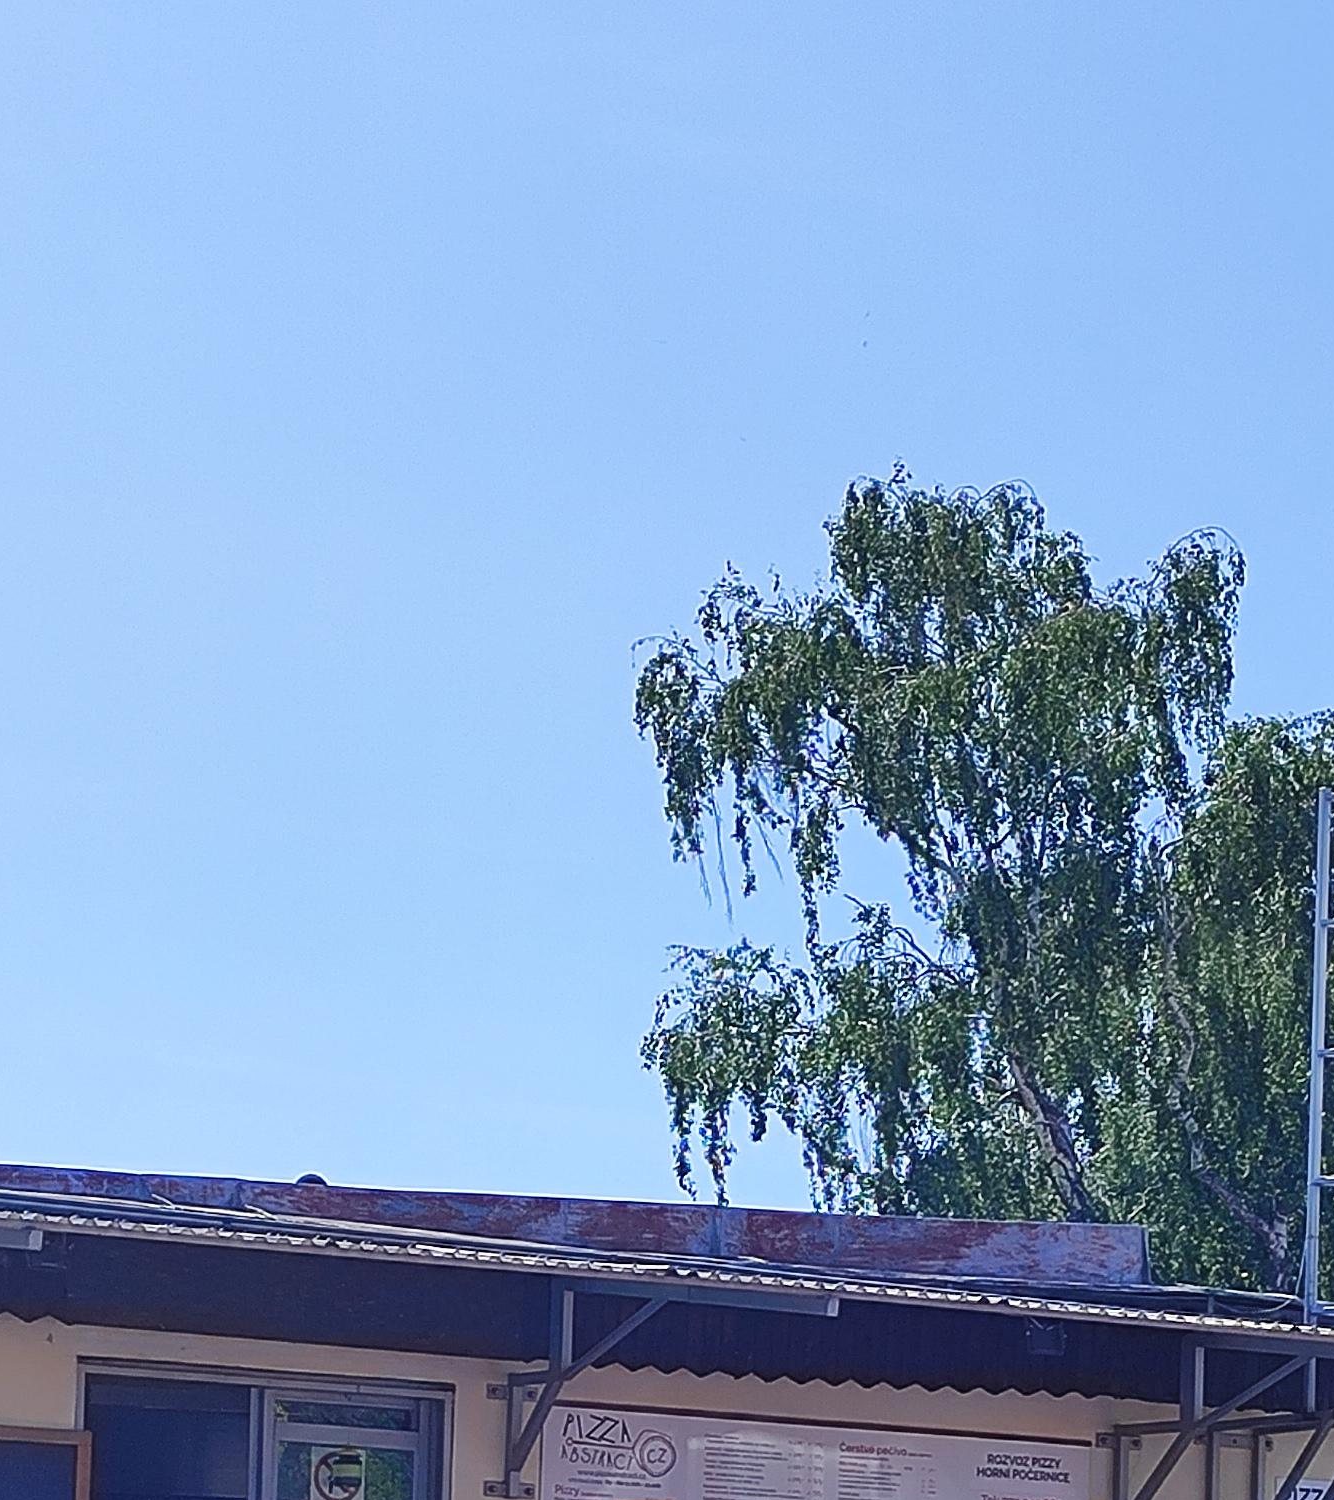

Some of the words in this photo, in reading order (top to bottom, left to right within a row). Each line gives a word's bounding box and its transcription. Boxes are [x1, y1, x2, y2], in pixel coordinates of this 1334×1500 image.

[562, 1412, 632, 1444] PIZZA
[561, 1443, 635, 1471] ABSTRACT
[647, 1447, 667, 1464] CZ
[987, 1454, 1030, 1467] ROZVOZ
[1031, 1457, 1061, 1469] PIZZY
[1013, 1468, 1070, 1484] POČERNICE
[554, 1484, 581, 1498] Pizzy
